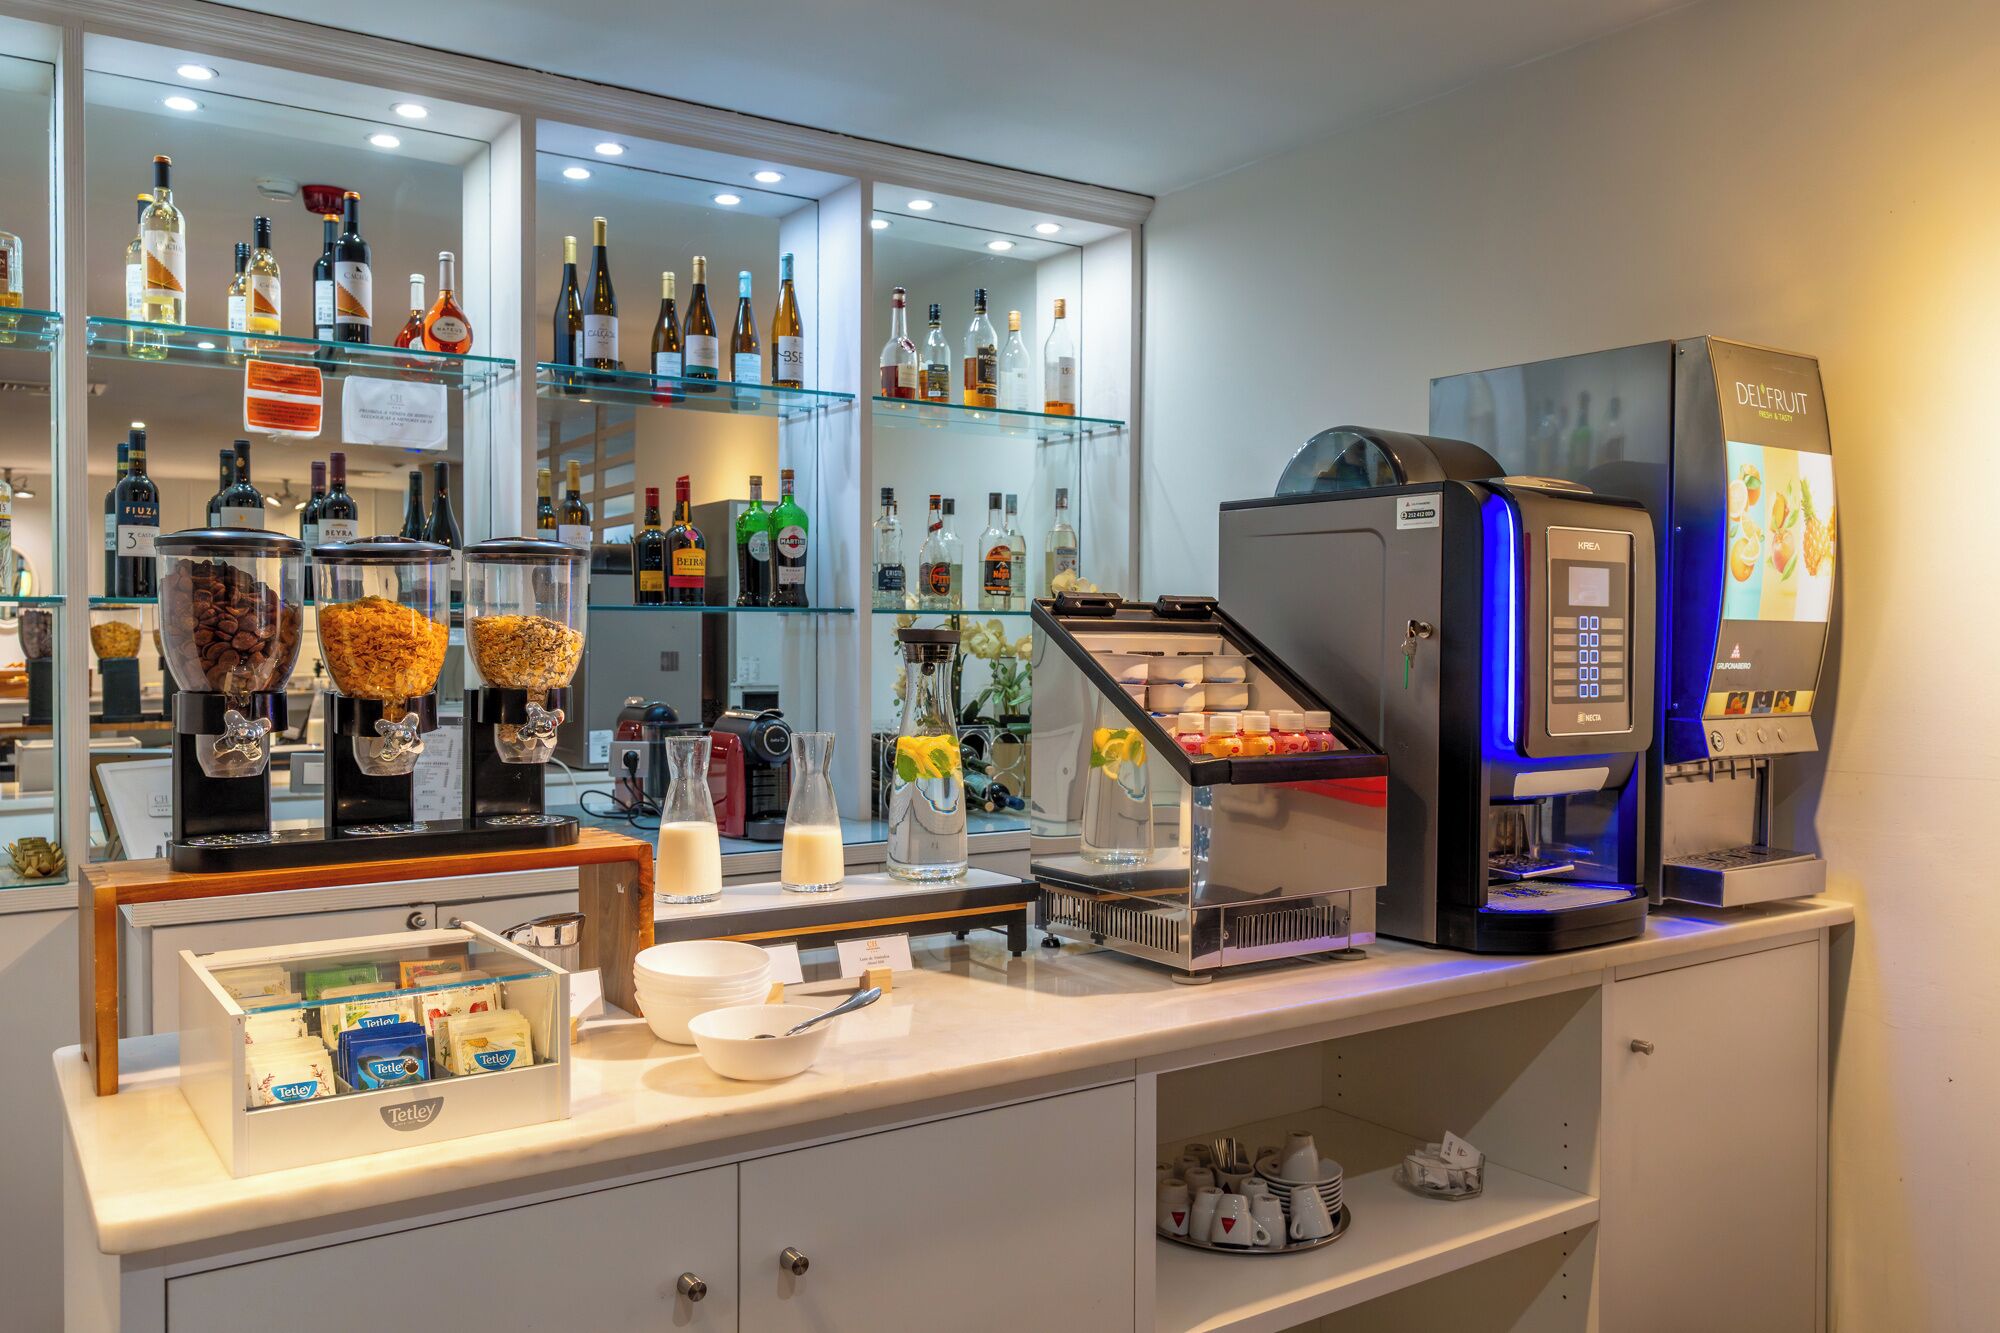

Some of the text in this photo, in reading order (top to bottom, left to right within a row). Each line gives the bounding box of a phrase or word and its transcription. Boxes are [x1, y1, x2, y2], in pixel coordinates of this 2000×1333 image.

[125, 506, 158, 516] FIUZA
[324, 529, 353, 538] BEYRA
[126, 532, 138, 549] 3
[1577, 541, 1601, 551] KREA
[1585, 713, 1602, 722] NECTA
[479, 1053, 511, 1066] Tetley
[277, 1084, 312, 1098] Tetley
[387, 1103, 436, 1123] Tetley
